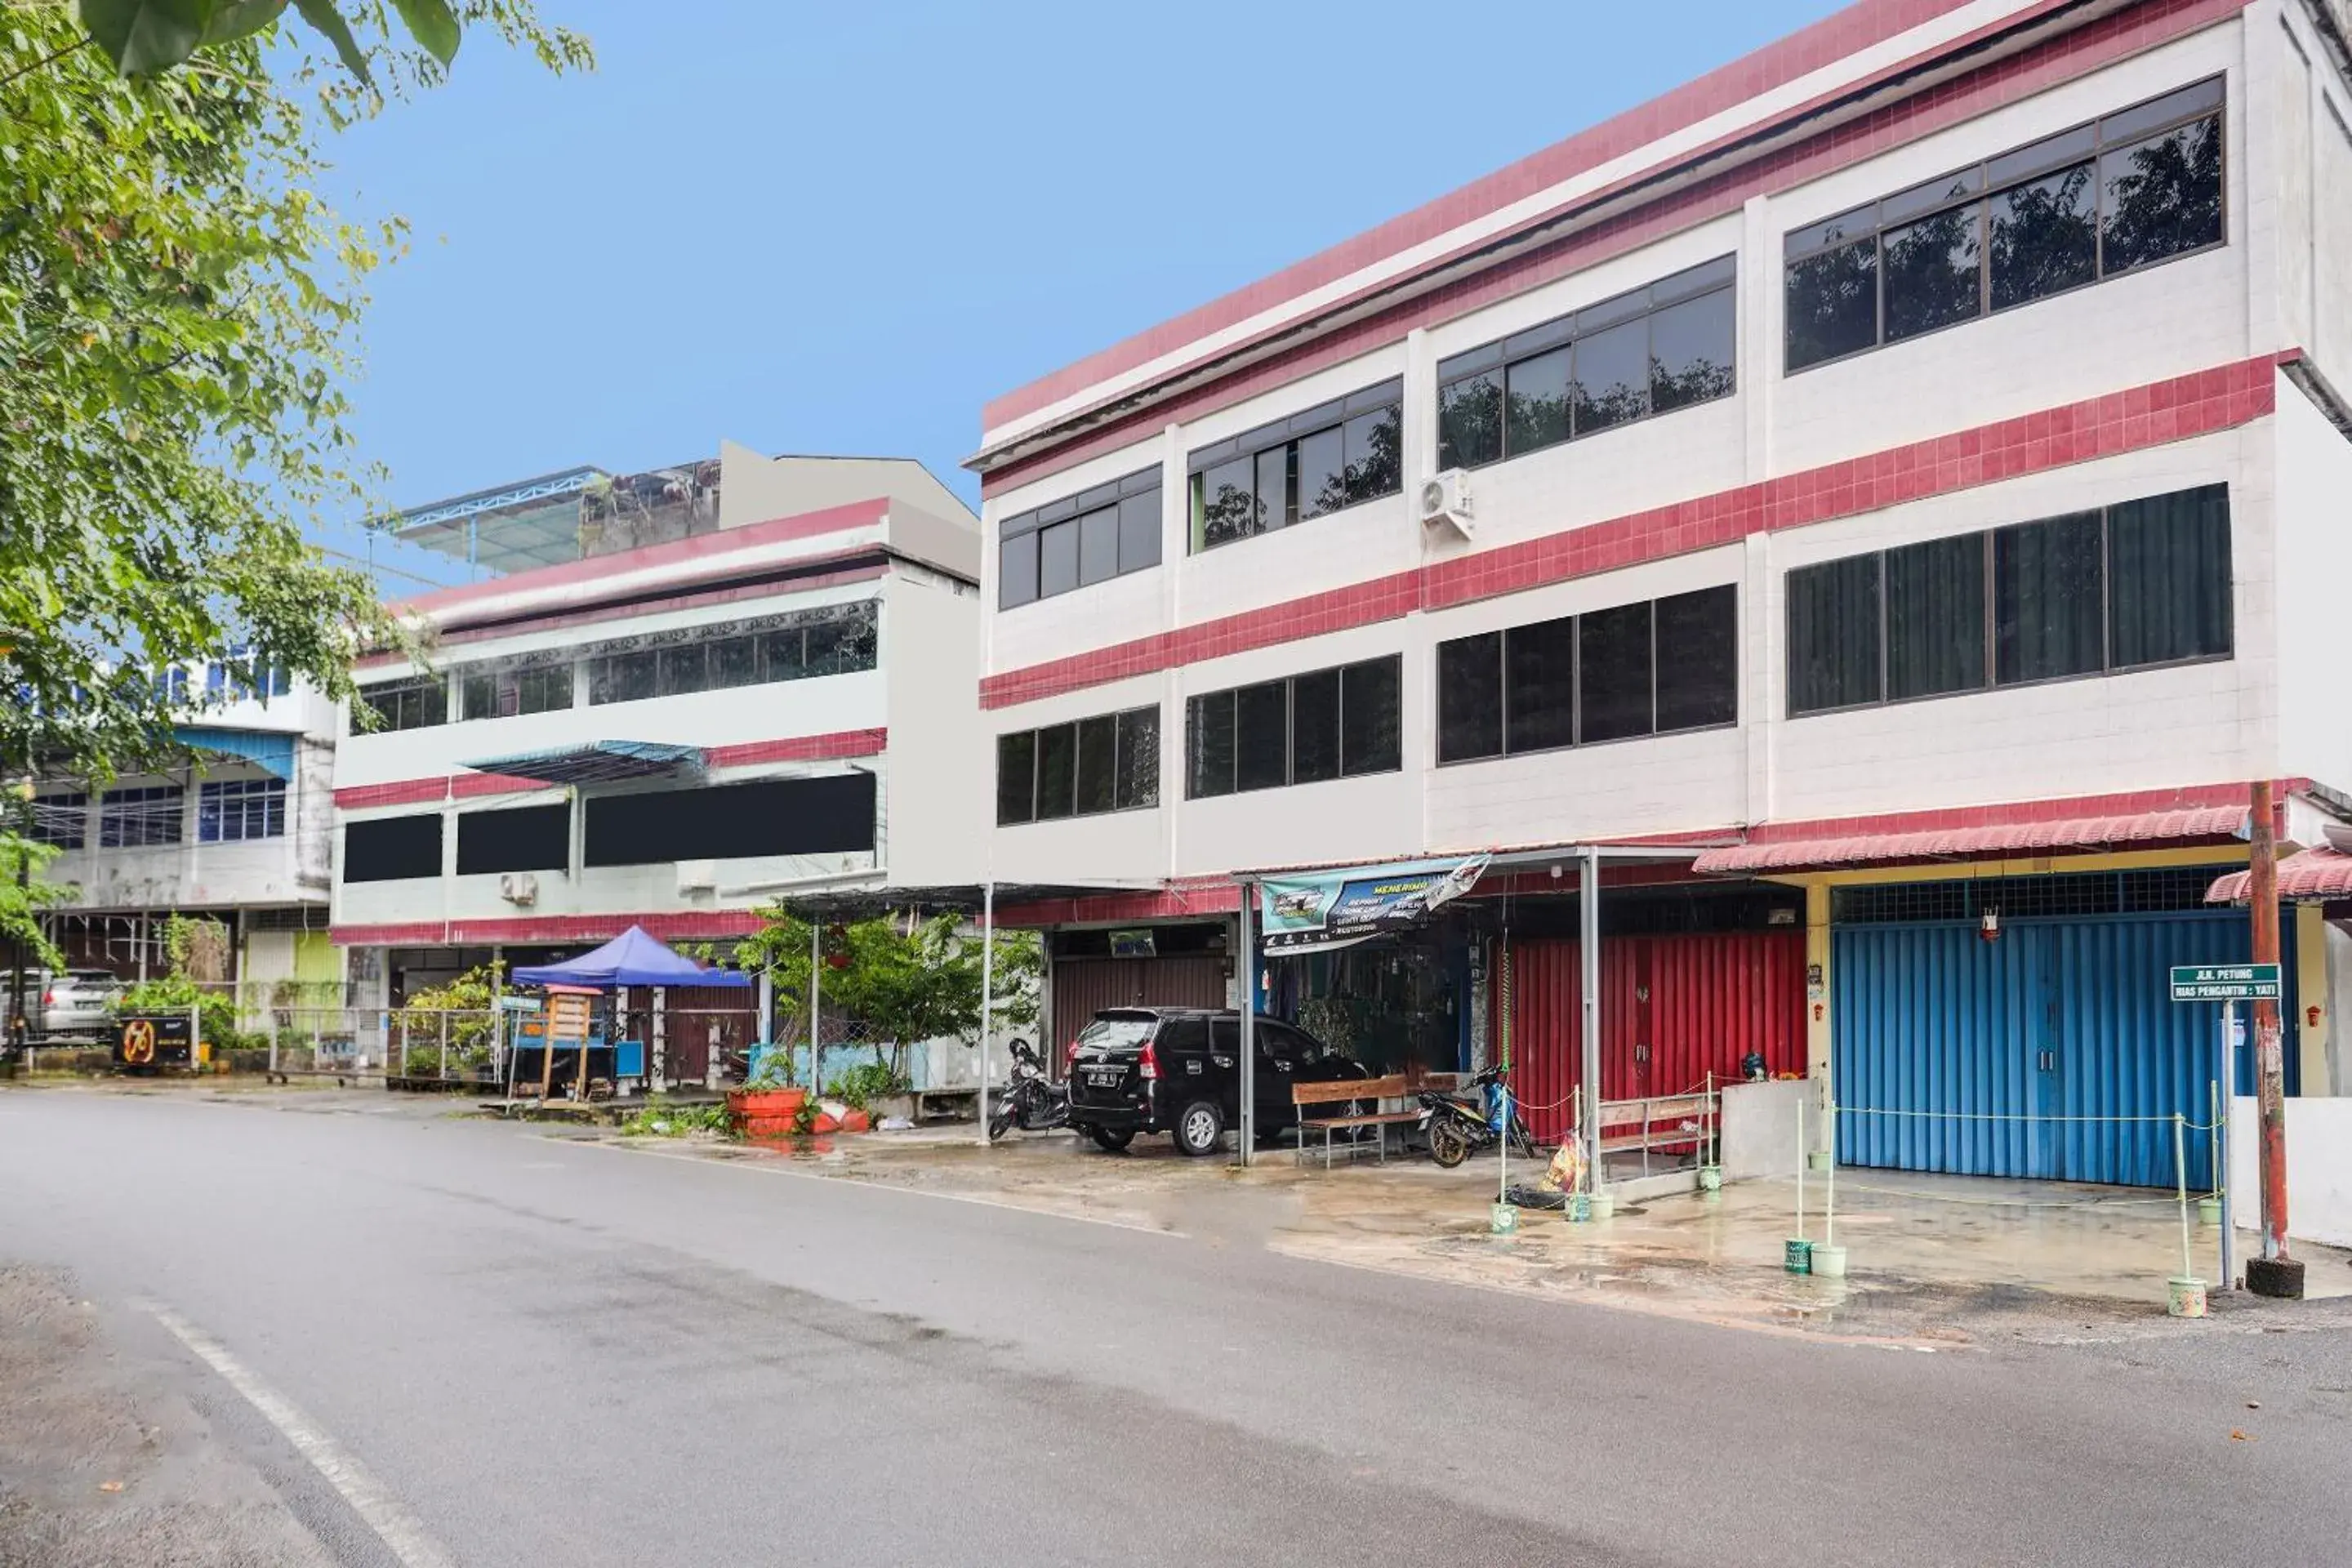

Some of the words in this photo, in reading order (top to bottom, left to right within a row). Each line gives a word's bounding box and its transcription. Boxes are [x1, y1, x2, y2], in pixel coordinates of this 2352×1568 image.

[2217, 969, 2253, 979] PETUNG
[2176, 986, 2196, 996] RIAS
[2198, 985, 2247, 996] PENGANTIN
[2255, 984, 2276, 995] YATI
